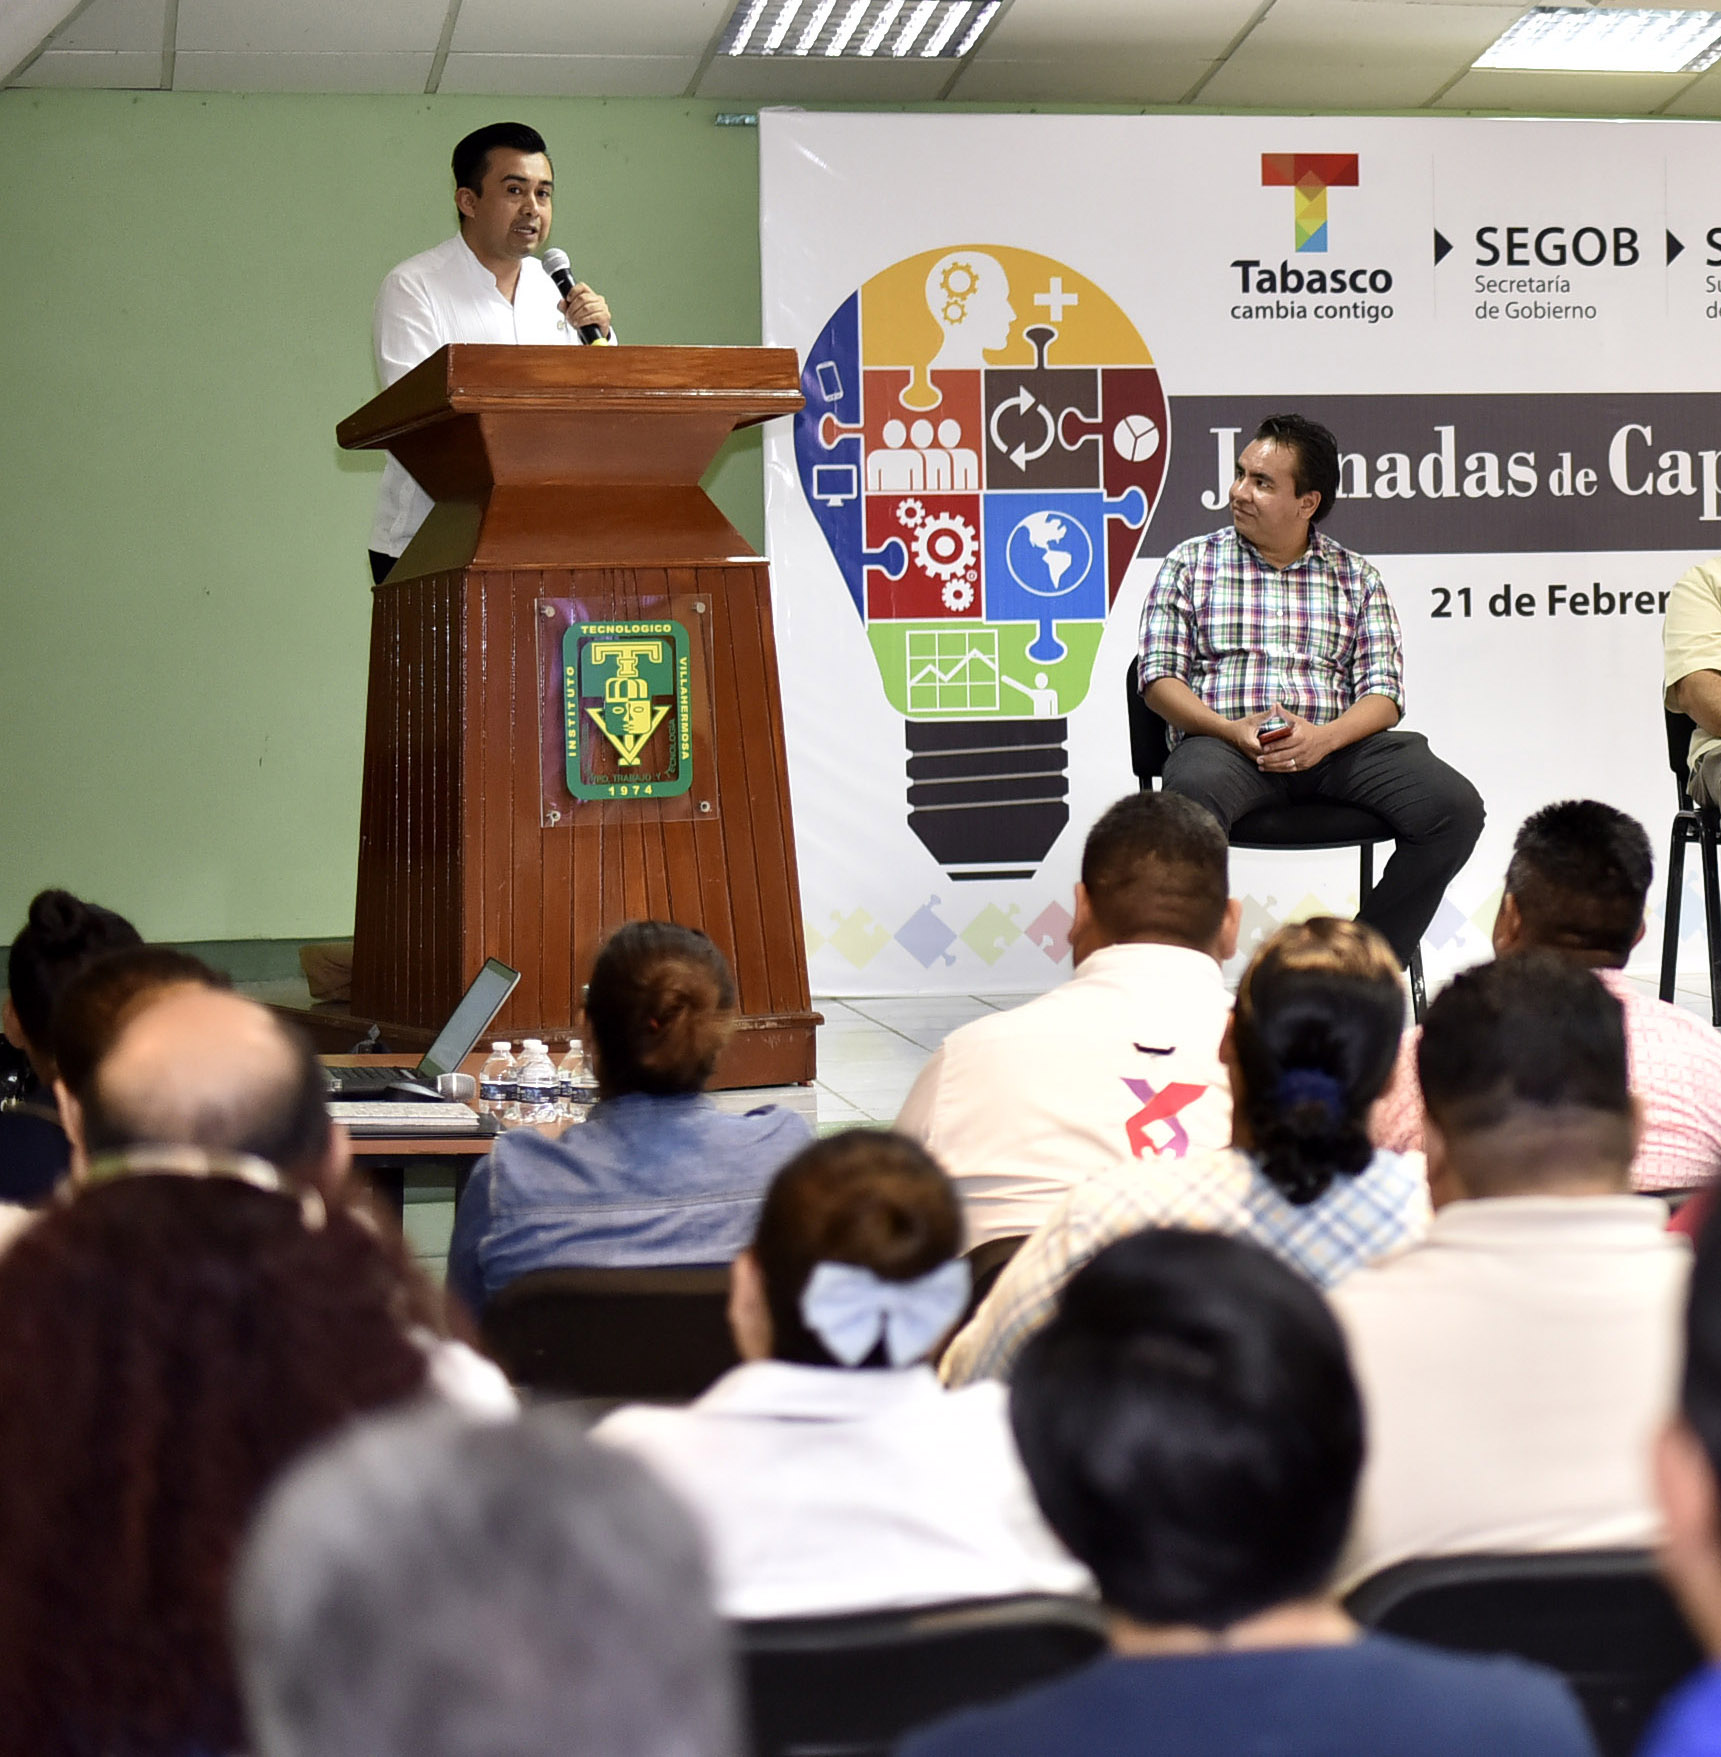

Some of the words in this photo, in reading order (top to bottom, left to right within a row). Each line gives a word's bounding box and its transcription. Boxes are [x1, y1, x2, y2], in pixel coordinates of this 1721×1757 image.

[1475, 226, 1640, 267] SEGOB
[1231, 260, 1393, 294] Tabasco
[1475, 275, 1571, 294] Secretaría
[1231, 302, 1308, 320] cambia
[1313, 302, 1394, 324] contigo
[1475, 302, 1499, 319] de
[1505, 302, 1597, 320] Gobierno
[1201, 426, 1539, 511] Jnadas
[1549, 453, 1598, 497] de
[1431, 587, 1472, 618] 21
[1489, 584, 1536, 617] de
[1548, 583, 1671, 616] Febrer
[581, 624, 672, 634] TECNOLOGICO
[567, 666, 577, 757] INSTITUTO
[679, 657, 689, 760] VILLAHERMOSA
[608, 785, 653, 796] 1974
